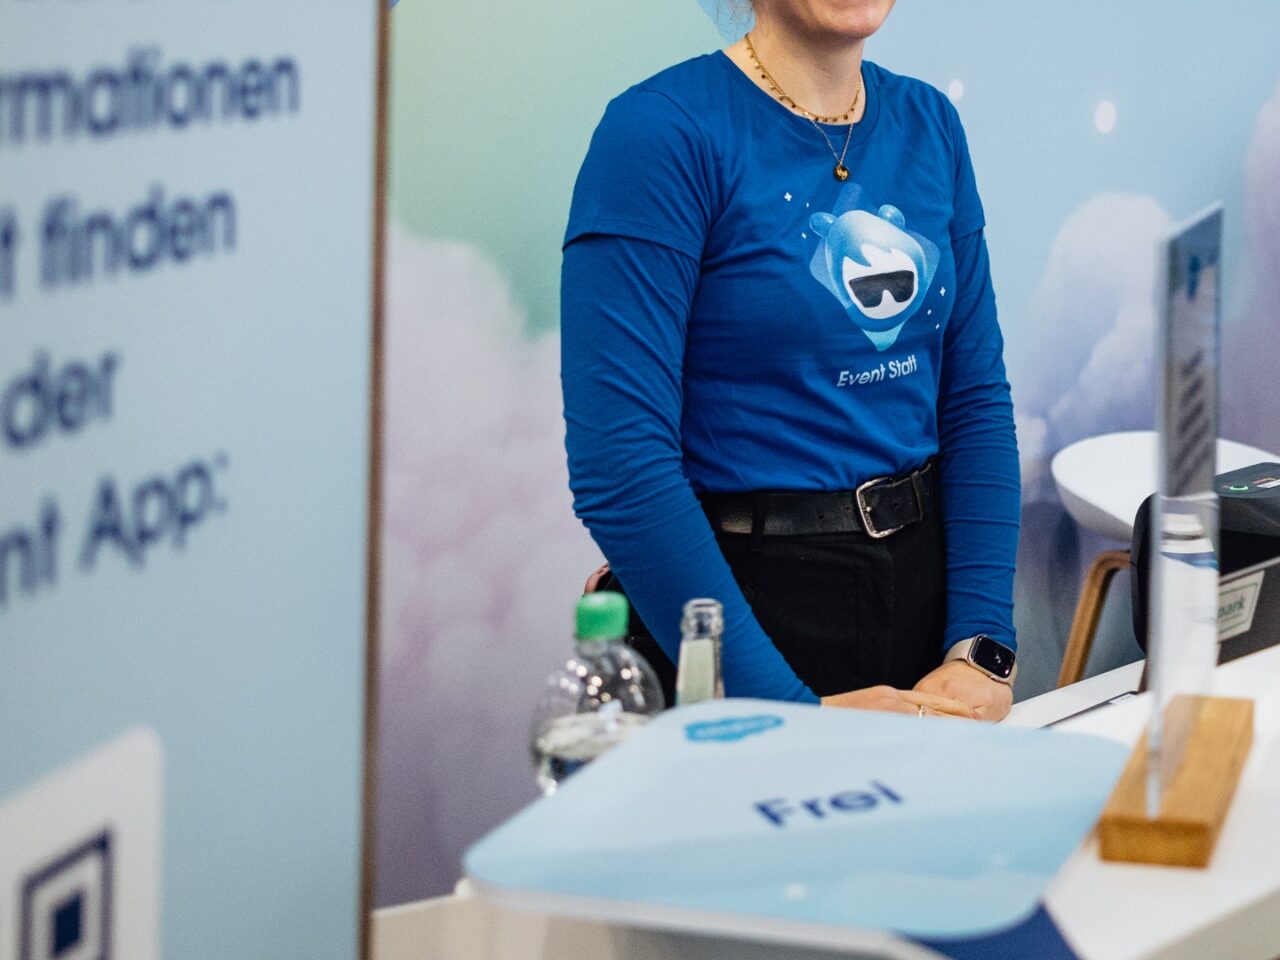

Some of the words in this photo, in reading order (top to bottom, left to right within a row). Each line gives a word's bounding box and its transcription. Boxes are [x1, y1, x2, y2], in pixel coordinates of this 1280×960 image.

[40, 182, 238, 290] finden
[1, 349, 118, 446] der
[836, 363, 885, 388] Event
[888, 354, 918, 379] Staff
[753, 779, 904, 828] Frei
